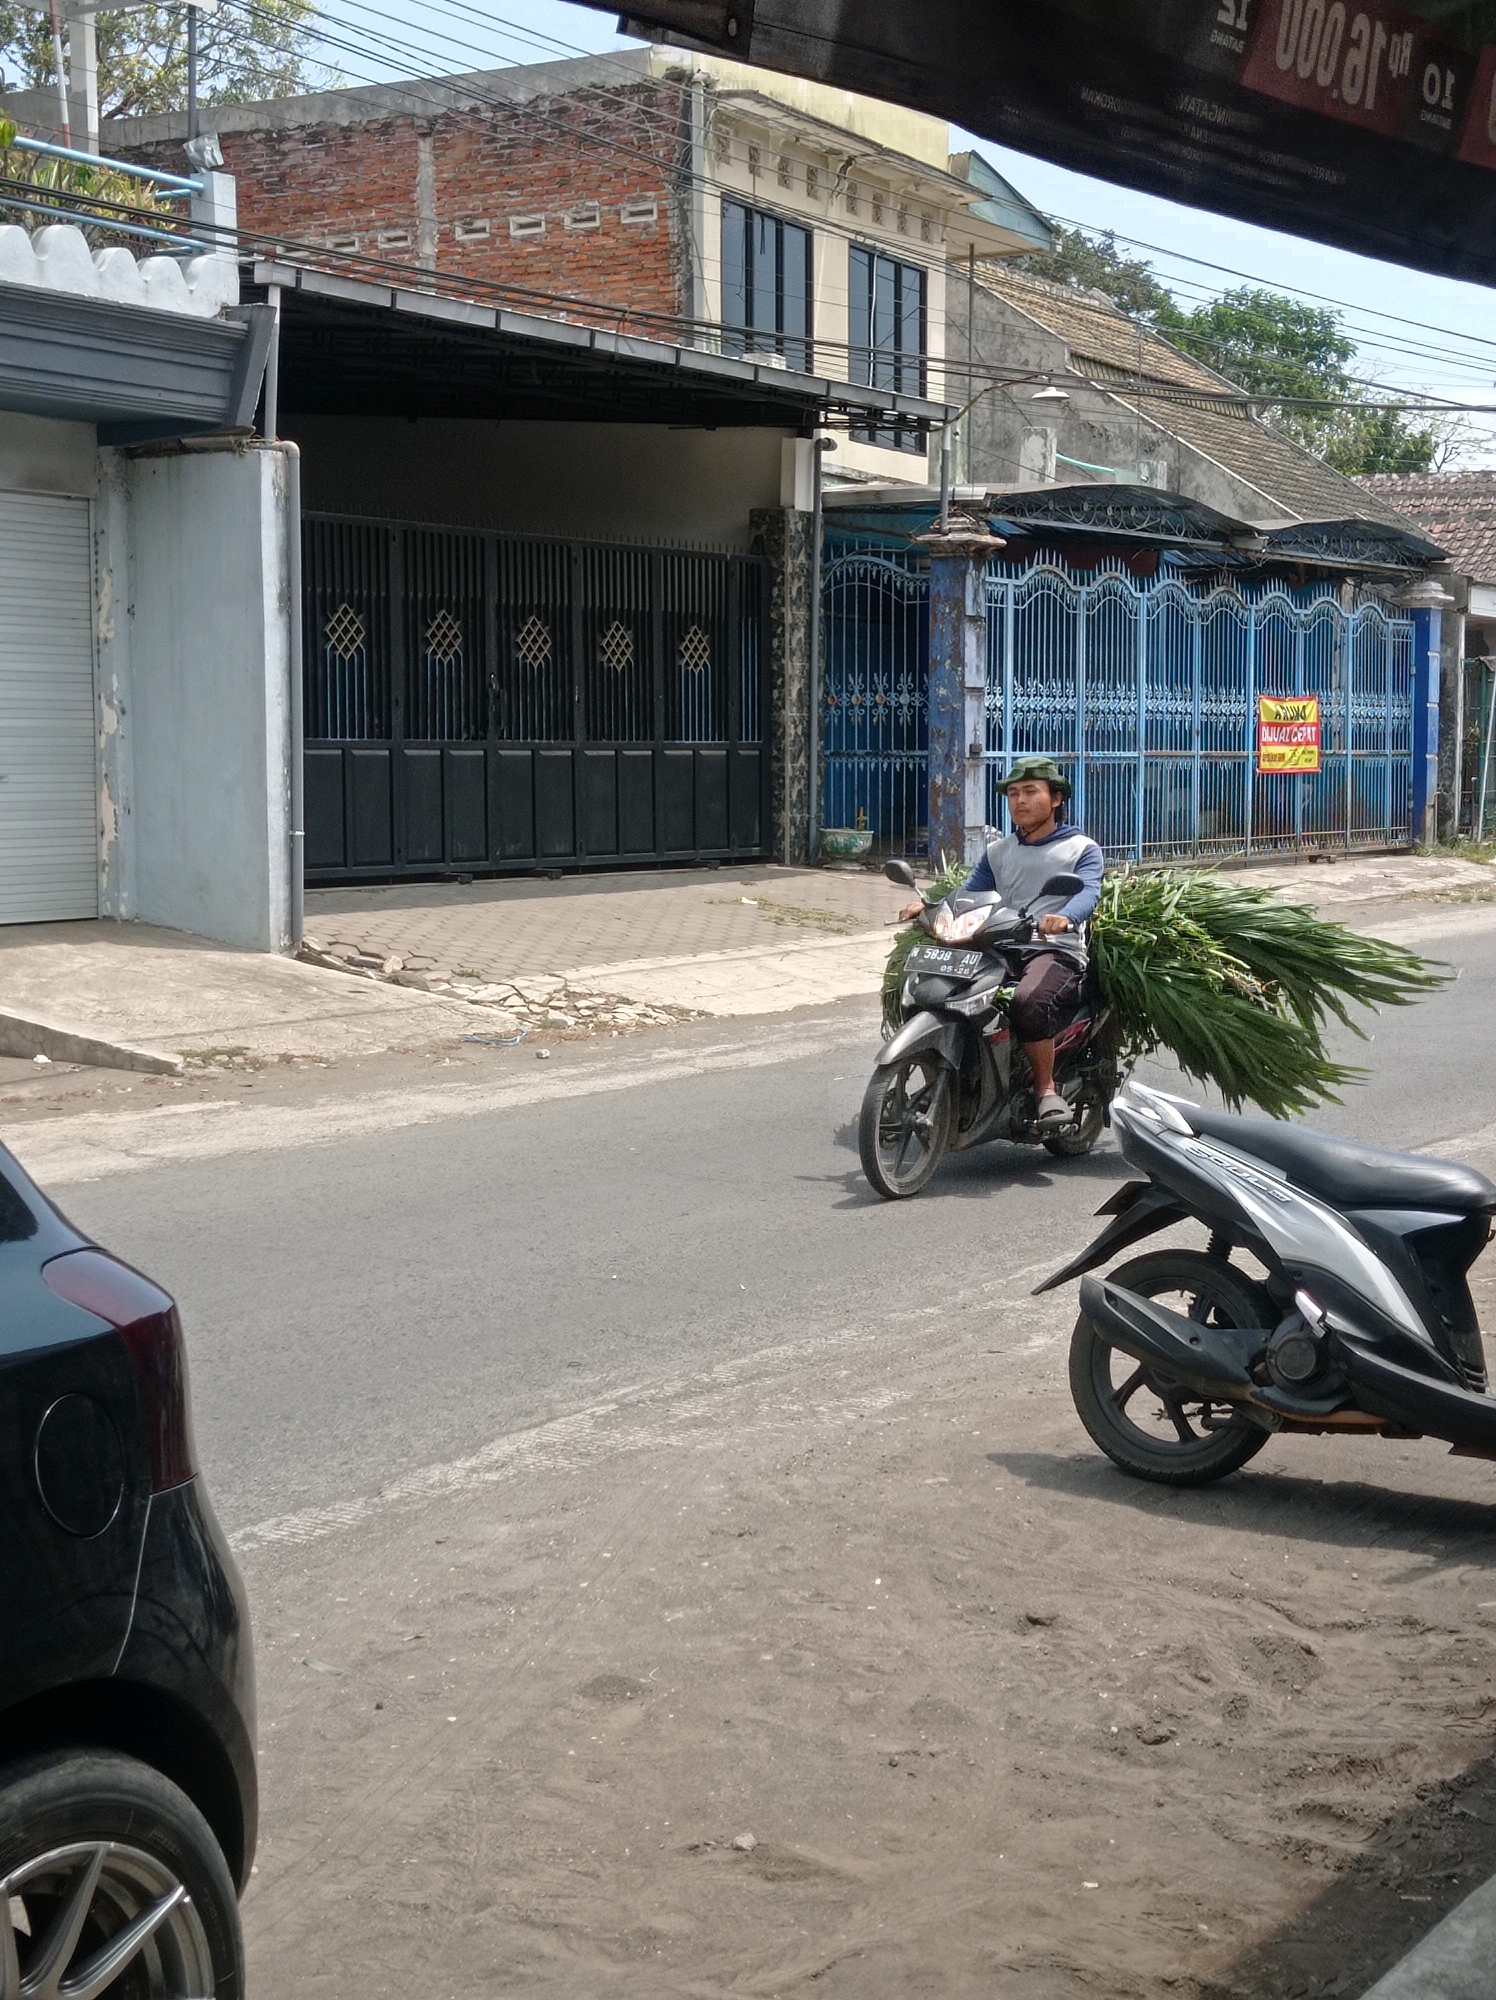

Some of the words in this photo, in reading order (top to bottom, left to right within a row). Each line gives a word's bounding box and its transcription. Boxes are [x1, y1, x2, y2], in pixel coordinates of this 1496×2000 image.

[1261, 725, 1290, 743] DIJUAL
[1291, 726, 1317, 743] CEPAT
[924, 948, 953, 961] 5838
[961, 954, 978, 965] AU
